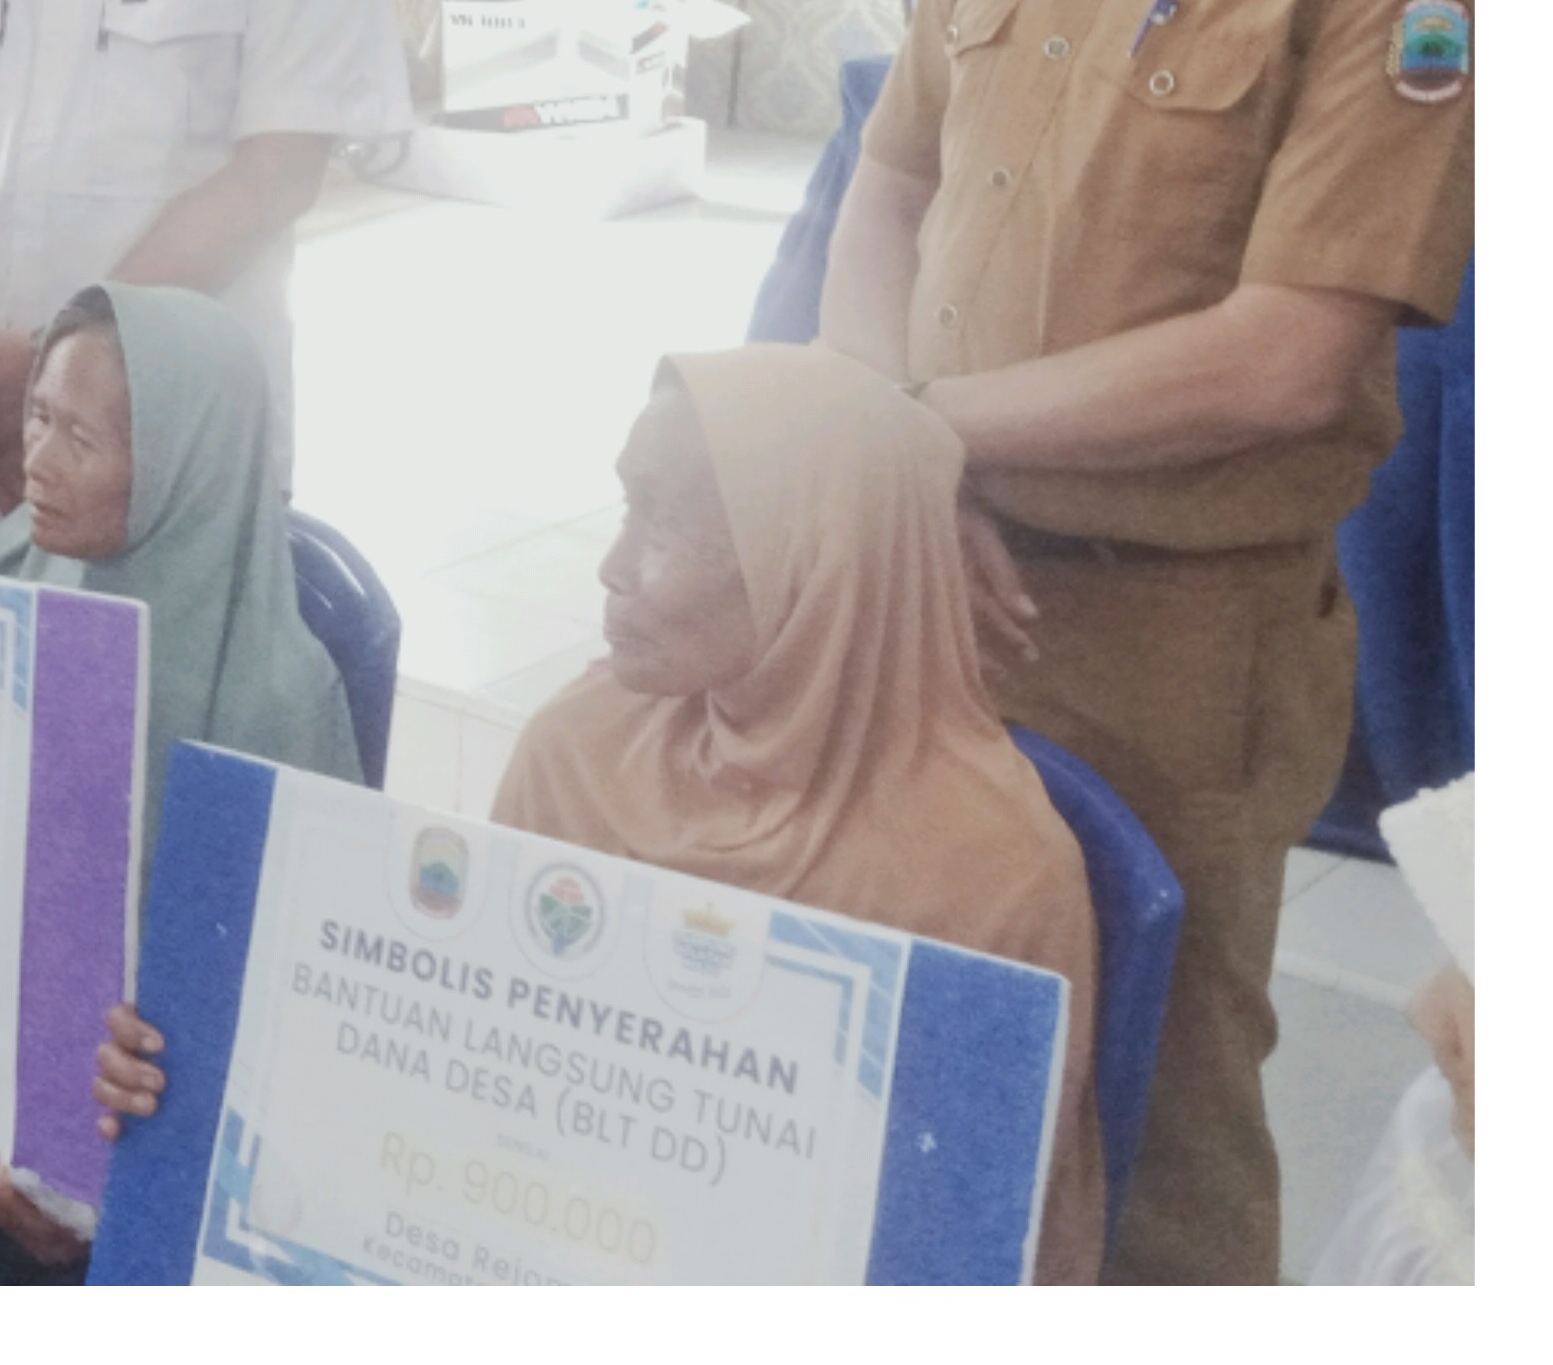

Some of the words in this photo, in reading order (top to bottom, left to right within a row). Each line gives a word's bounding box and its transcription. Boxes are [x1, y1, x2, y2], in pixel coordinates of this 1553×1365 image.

[291, 960, 453, 1043] BANTUAN
[464, 1018, 676, 1114] LANGSUNG
[693, 1087, 816, 1161] TUNAI
[318, 918, 494, 1001] SIMBOLIS
[507, 975, 800, 1097] PENYERAHAN
[336, 1020, 431, 1083] DANA
[445, 1058, 538, 1120] DESA
[555, 1085, 638, 1151] (BLT
[649, 1125, 728, 1188] DD)
[380, 1131, 444, 1196] Rp.
[463, 1159, 657, 1267] 900.000
[386, 1210, 461, 1261] Desa
